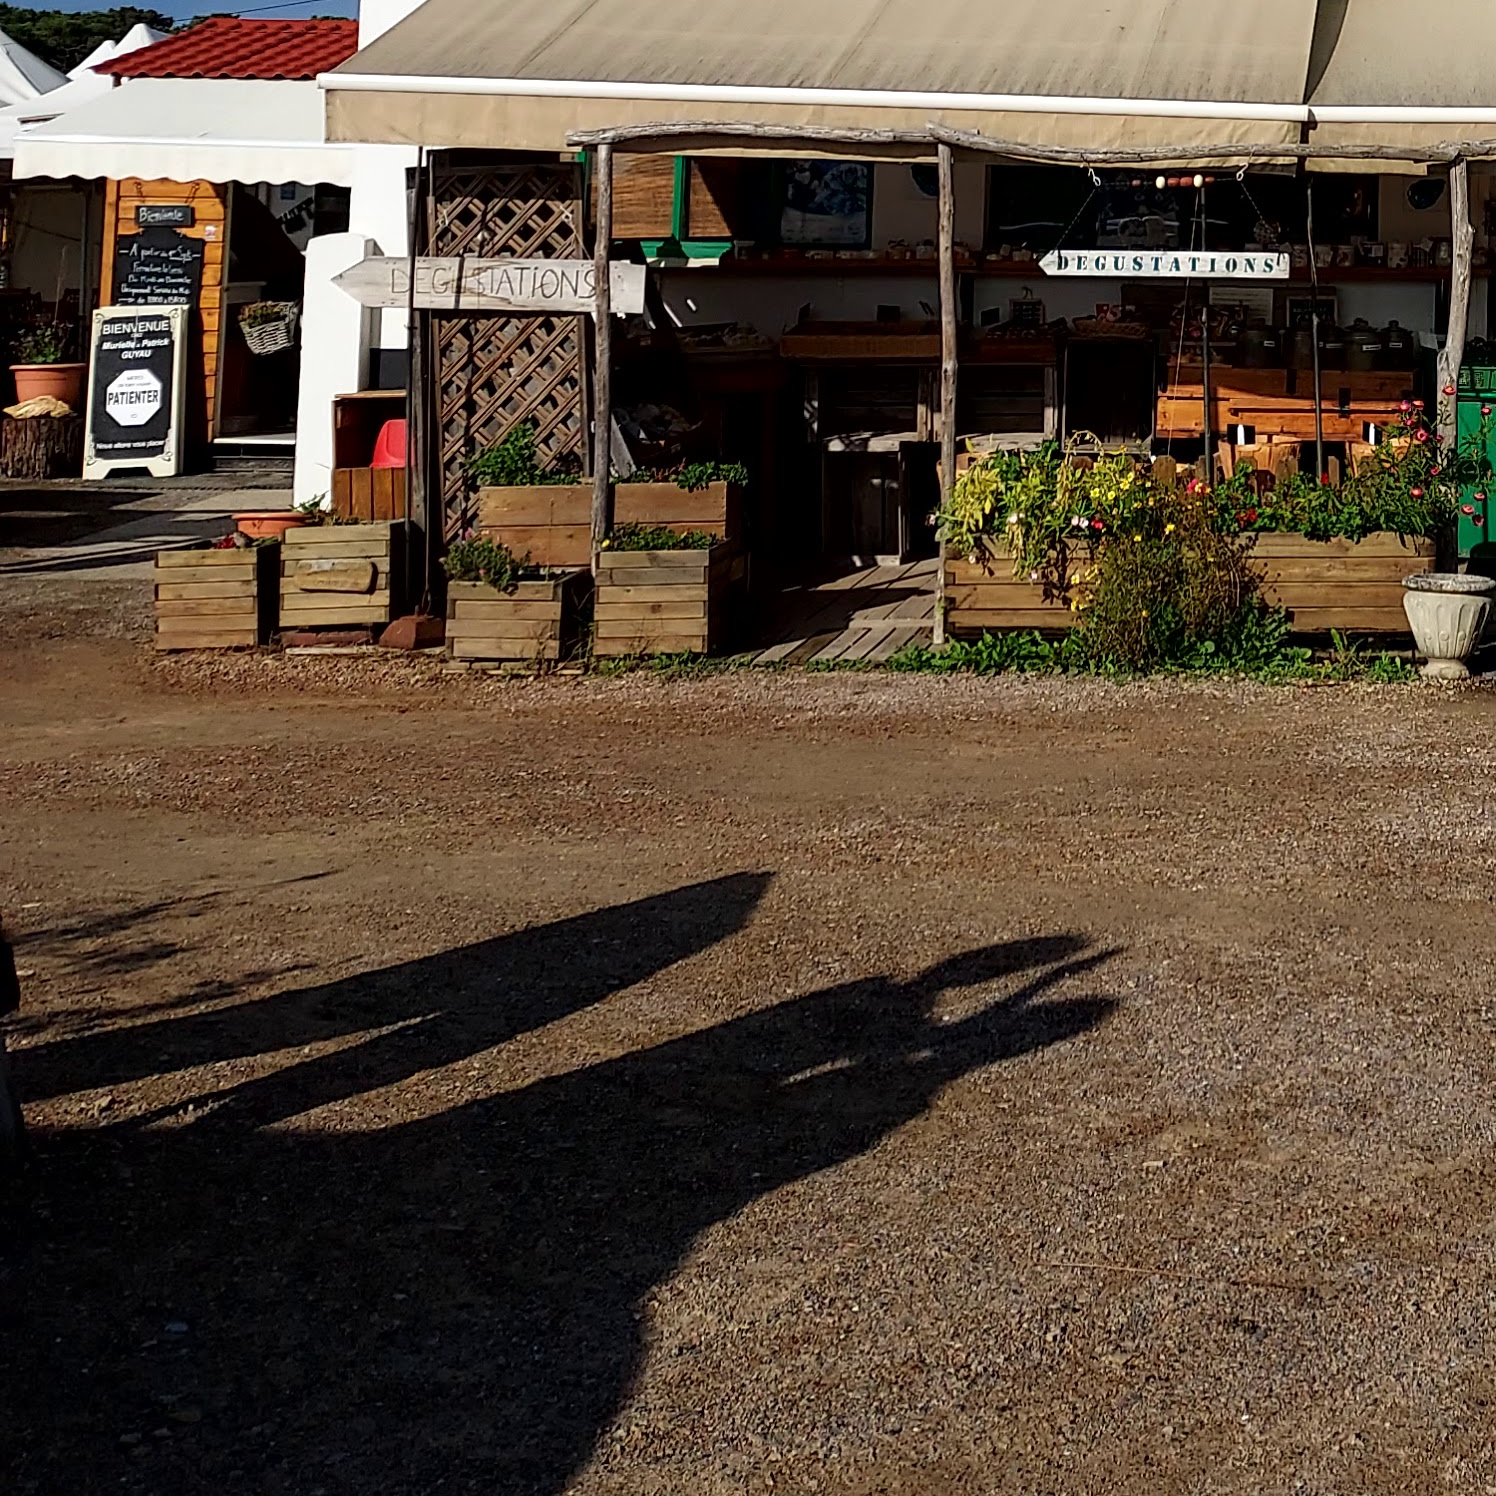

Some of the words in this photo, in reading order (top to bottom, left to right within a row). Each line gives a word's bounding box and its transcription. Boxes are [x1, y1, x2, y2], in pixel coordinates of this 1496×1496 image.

[1056, 255, 1275, 273] DEGUSTATIONS
[391, 265, 598, 299] DEGUSTATIONS
[102, 320, 169, 335] BIENVENUE
[121, 349, 152, 359] GUYAU
[107, 389, 159, 406] PATIENTER
